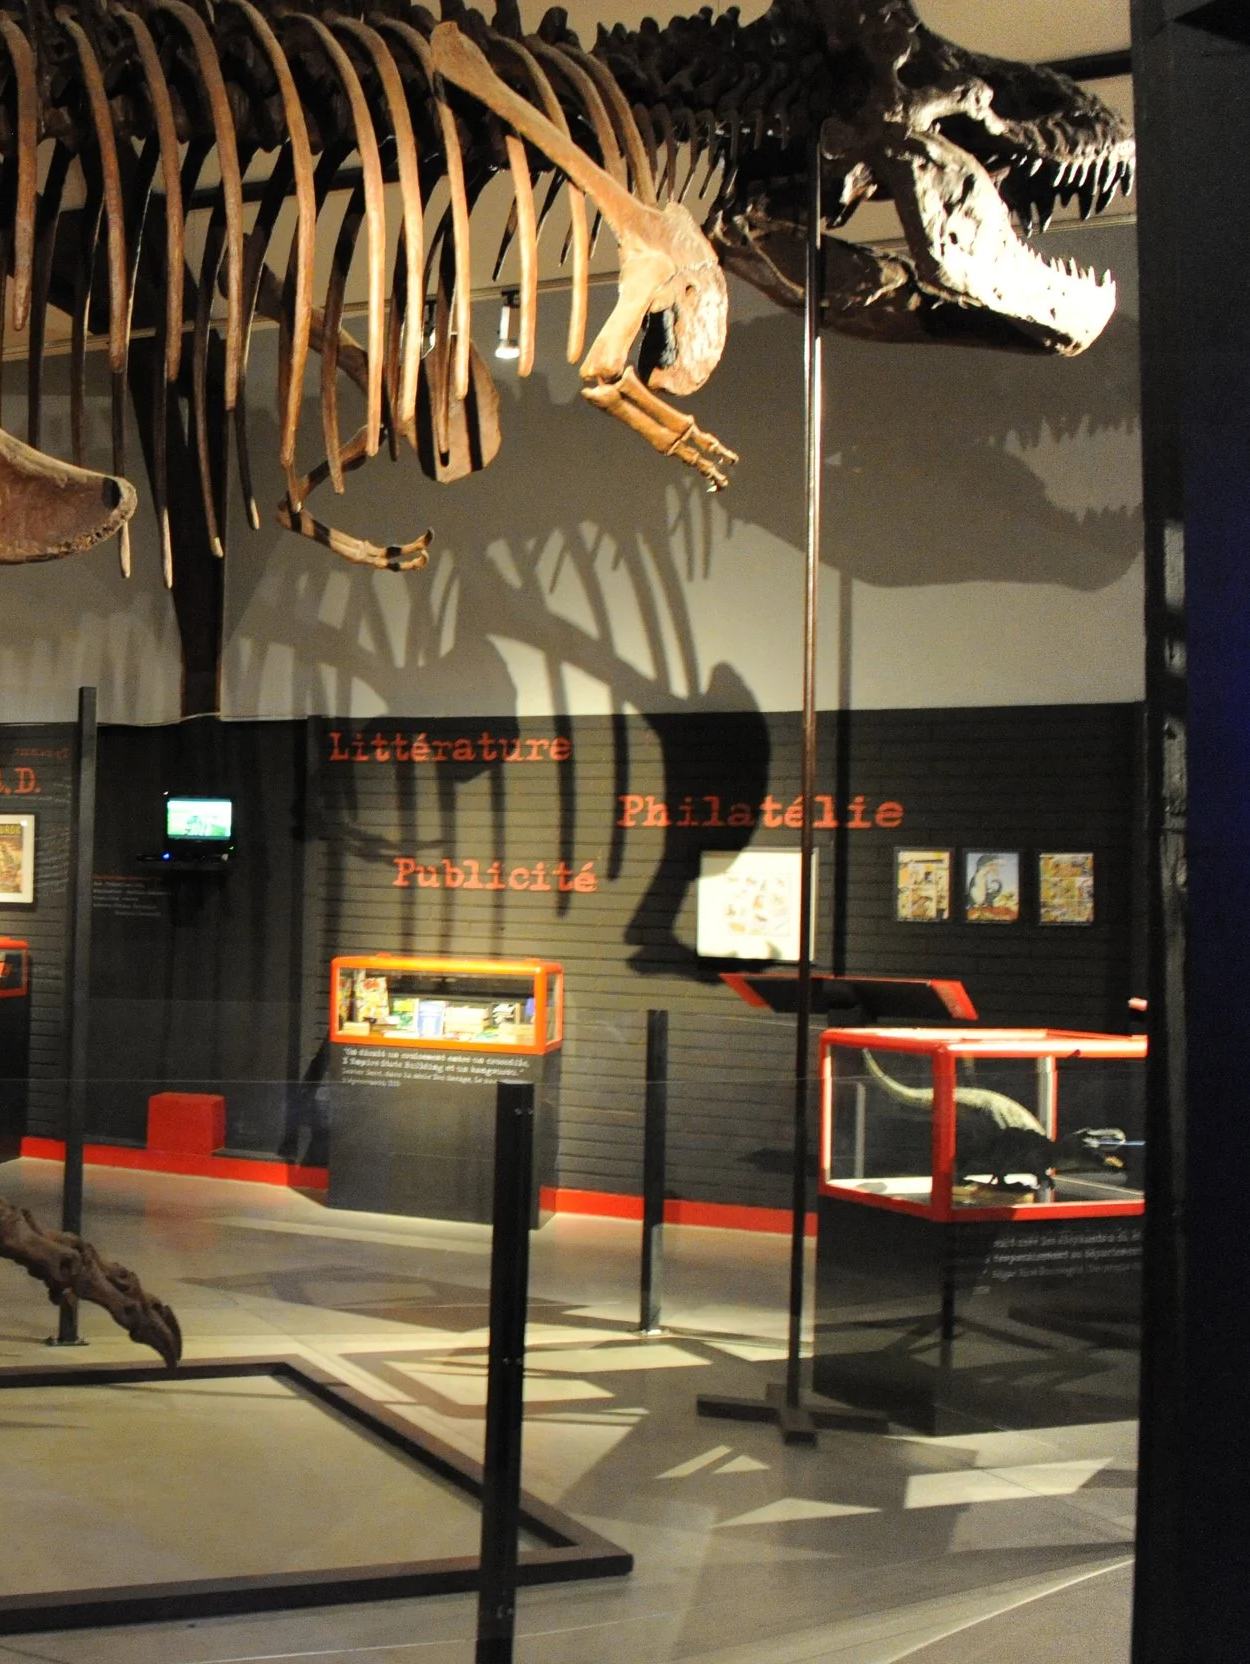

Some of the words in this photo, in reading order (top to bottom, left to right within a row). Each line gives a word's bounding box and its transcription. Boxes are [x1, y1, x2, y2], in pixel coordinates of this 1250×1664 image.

[329, 731, 572, 762] Littérature
[617, 793, 905, 829] Philatélie
[392, 856, 599, 893] Publicité
